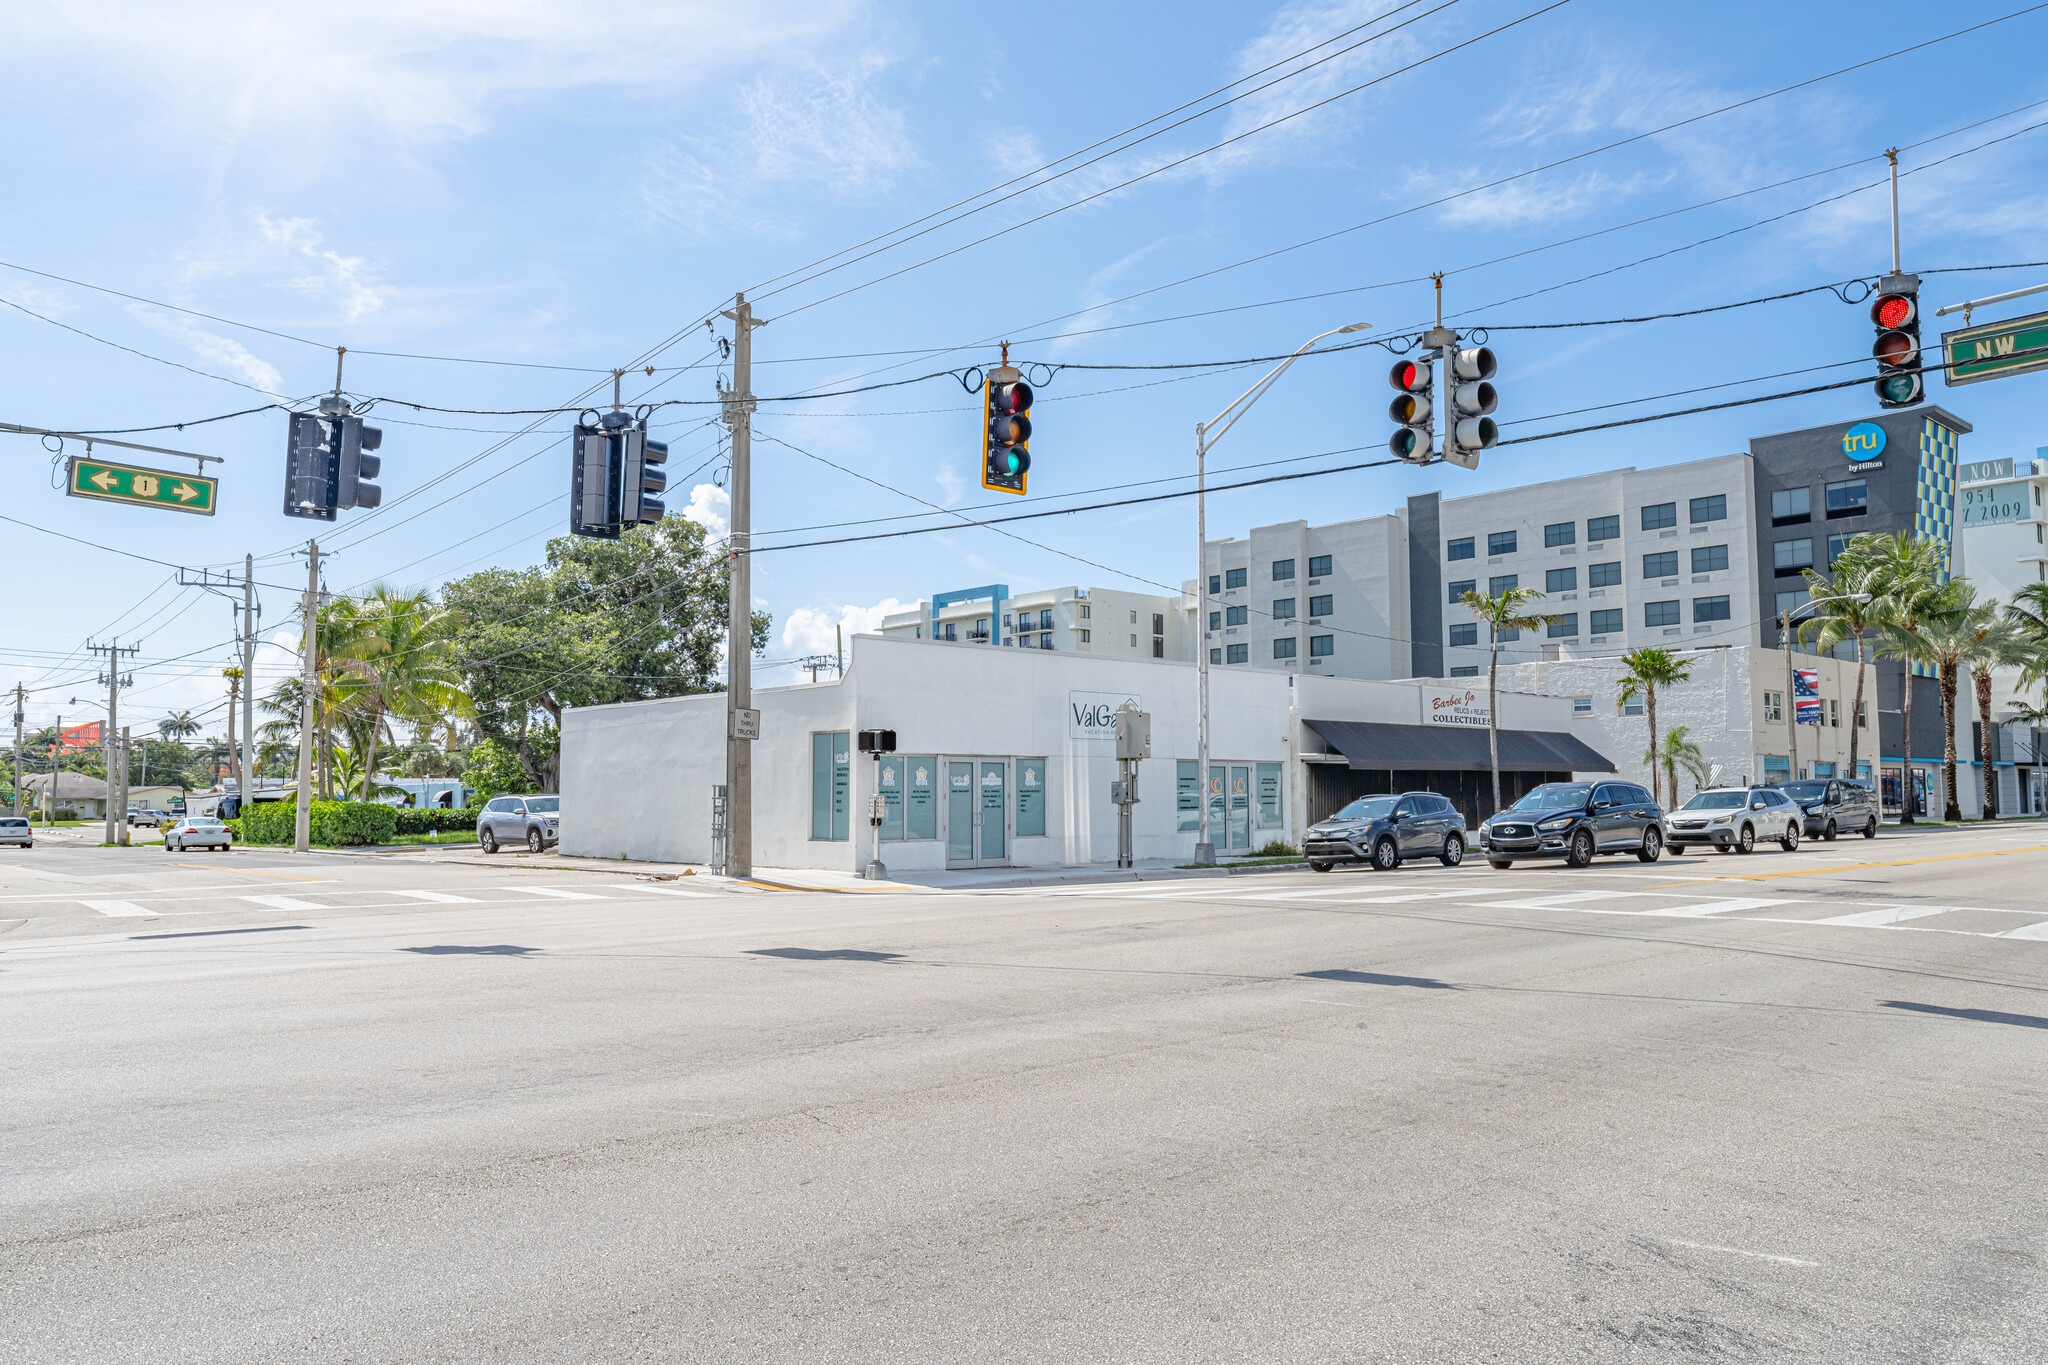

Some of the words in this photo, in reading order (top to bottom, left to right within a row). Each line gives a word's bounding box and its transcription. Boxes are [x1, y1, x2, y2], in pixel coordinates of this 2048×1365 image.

[1976, 335, 2014, 360] NW
[1842, 433, 1877, 452] tru
[1848, 464, 1858, 472] by
[1859, 461, 1883, 470] Hilton
[1971, 460, 2004, 479] NOW
[143, 480, 148, 491] 1
[1966, 488, 1994, 505] 954
[1980, 501, 2021, 520] 2009
[1432, 694, 1462, 710] Barbee
[1465, 690, 1475, 706] Jo
[744, 711, 751, 719] NO
[1433, 715, 1491, 725] COLLECTIBLES
[737, 728, 756, 736] TRUCKS
